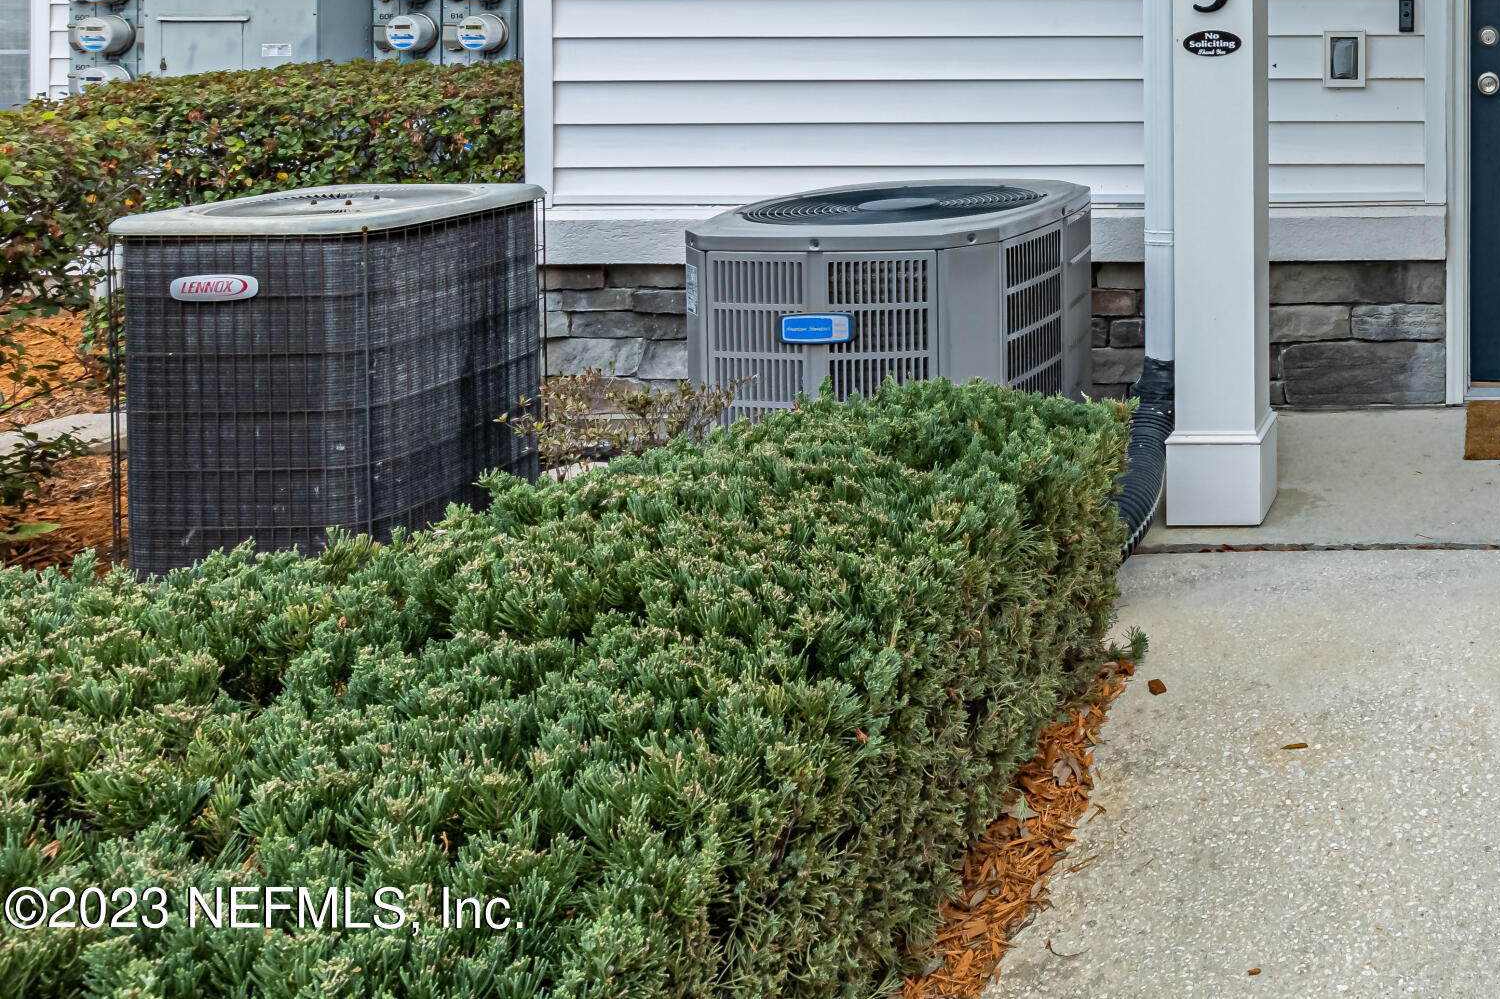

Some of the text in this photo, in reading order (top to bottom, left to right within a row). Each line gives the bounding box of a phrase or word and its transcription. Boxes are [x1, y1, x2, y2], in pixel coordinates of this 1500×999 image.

[1204, 32, 1220, 40] No
[1189, 40, 1236, 49] Soliciting
[181, 281, 234, 294] LENNOX
